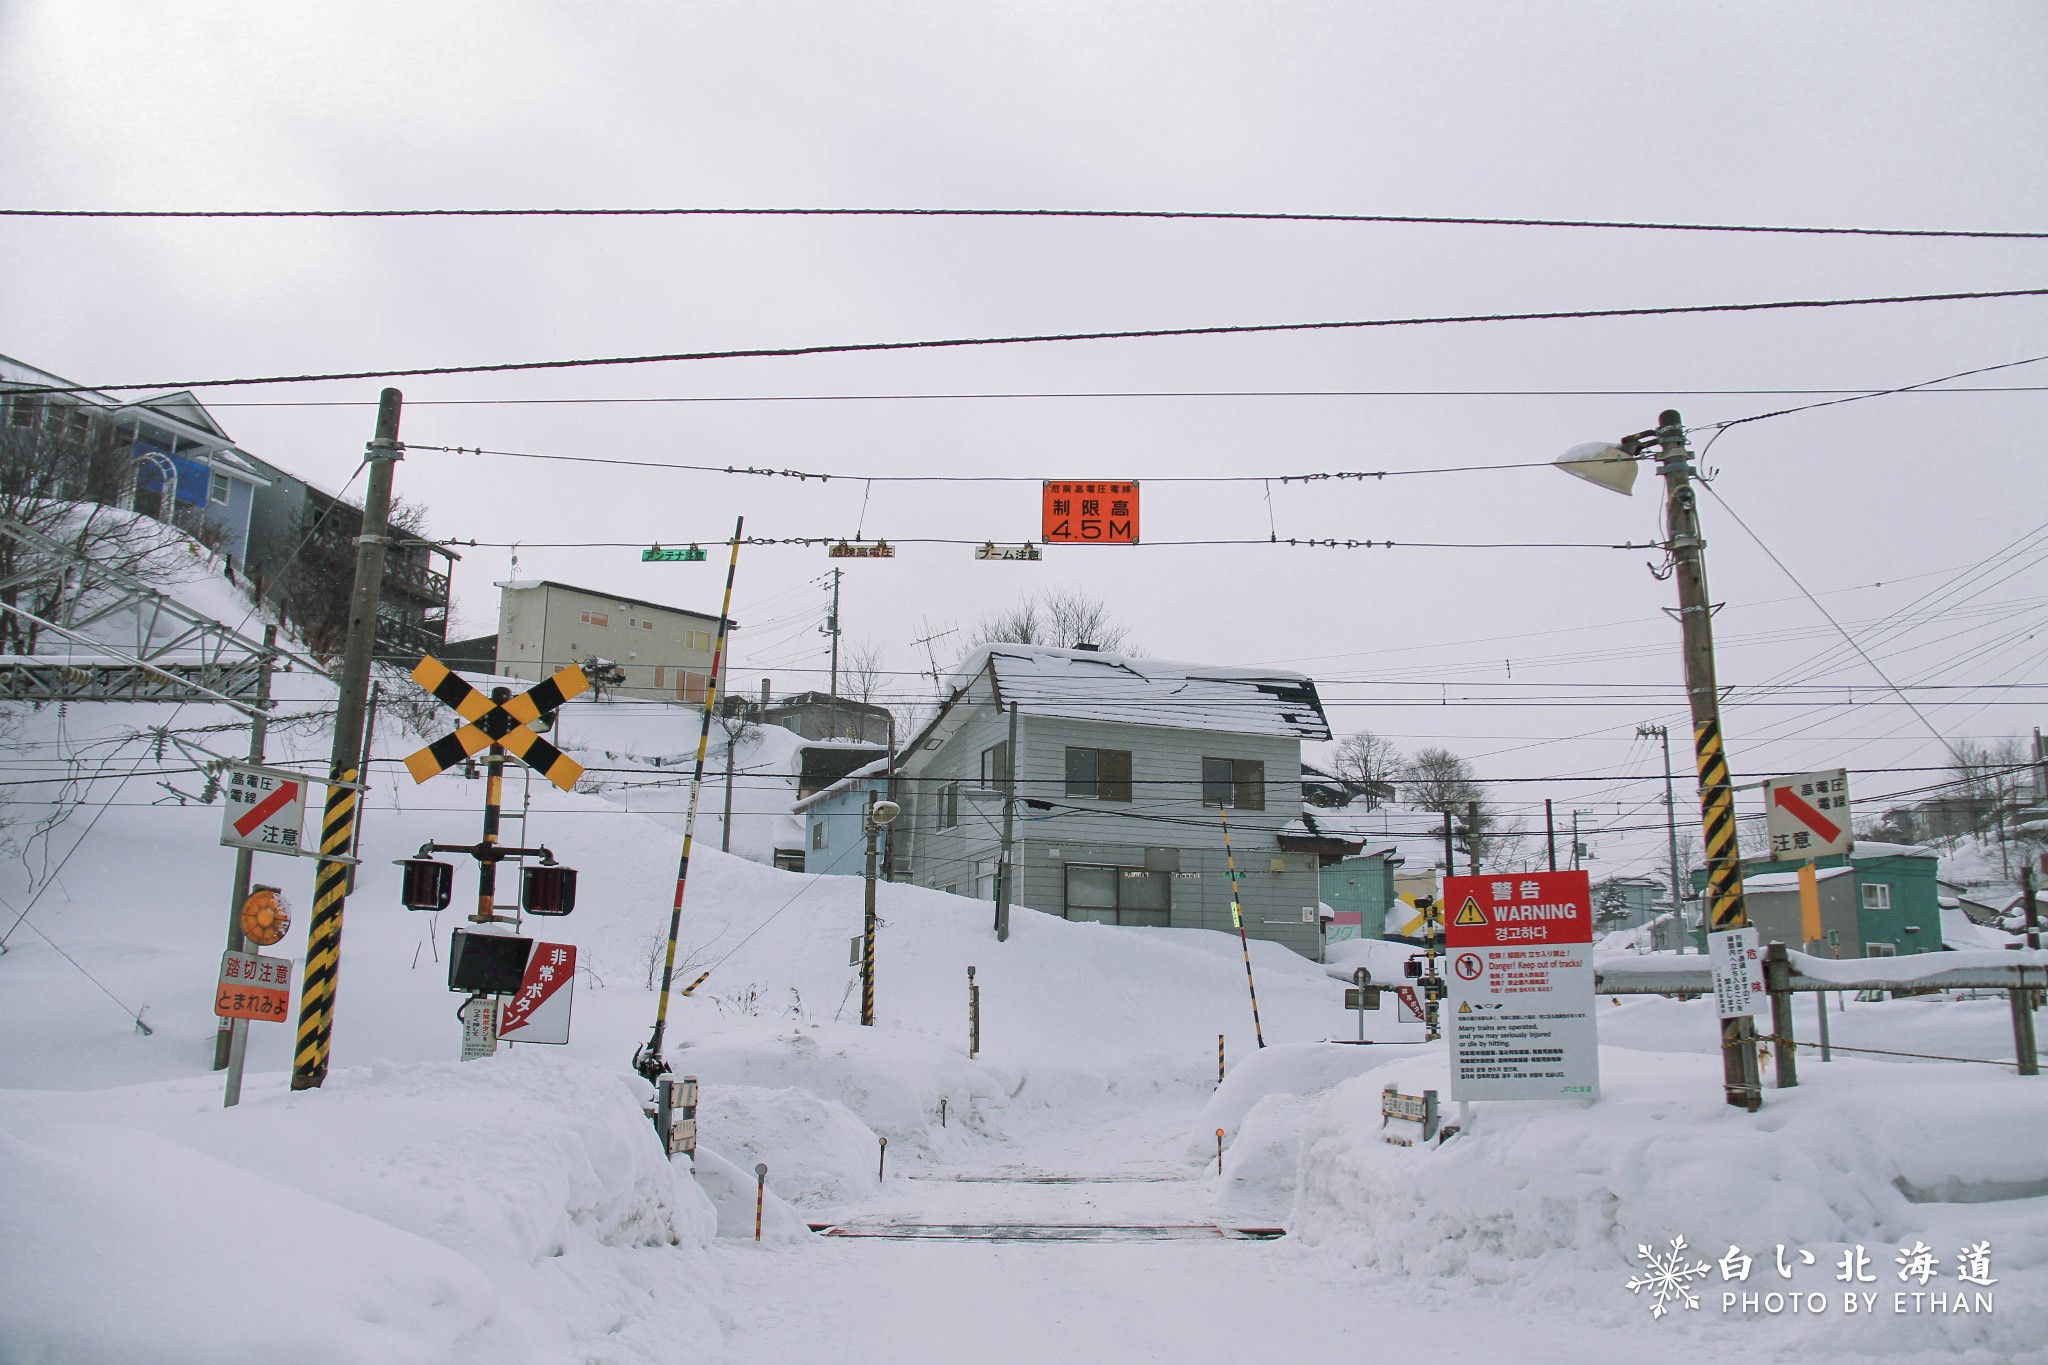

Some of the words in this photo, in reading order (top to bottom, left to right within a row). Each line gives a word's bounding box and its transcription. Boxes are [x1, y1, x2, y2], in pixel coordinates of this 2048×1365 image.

[1051, 484, 1132, 494] 危険高電圧電線
[1053, 499, 1129, 517] 制限高
[832, 547, 893, 558] 危険高電圧
[232, 772, 273, 791] 高電圧
[1800, 778, 1846, 797] 高電圧
[230, 788, 258, 806] 電線
[1817, 795, 1847, 811] 電線
[261, 824, 299, 847] 注意
[1772, 830, 1813, 853] 注意
[1491, 880, 1541, 901] 警告
[1493, 903, 1577, 922] WARNING
[1495, 925, 1548, 941] 경고하다
[224, 957, 289, 984] 踏切注意
[1489, 962, 1516, 972] Danger!
[1518, 961, 1536, 971] Keep
[1550, 960, 1559, 968] of
[1559, 959, 1583, 968] tracks!
[1746, 948, 1763, 993] 危険
[505, 948, 568, 1027] 非常ボタン
[218, 990, 287, 1016] とまれみよ
[1402, 988, 1424, 1017] 非常ボタン
[1458, 1025, 1476, 1033] Many
[1472, 1033, 1484, 1041] you
[1500, 1031, 1528, 1039] seriously
[1479, 1040, 1487, 1048] by
